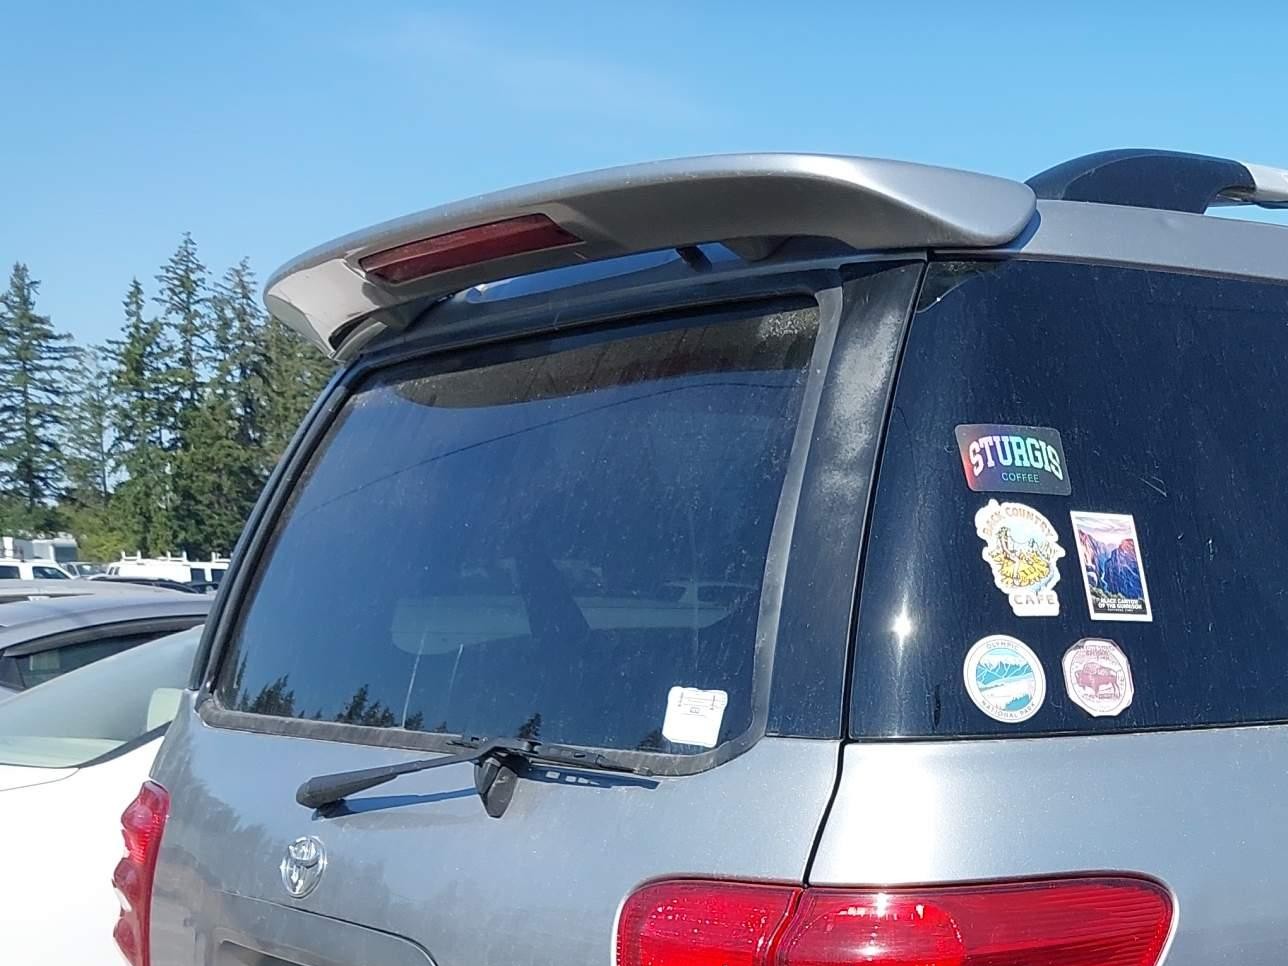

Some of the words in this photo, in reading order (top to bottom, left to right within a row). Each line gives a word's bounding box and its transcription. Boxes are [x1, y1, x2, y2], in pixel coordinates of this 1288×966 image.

[968, 434, 1064, 481] STURGIS
[1001, 472, 1040, 484] COFFEE
[1004, 506, 1054, 537] COUNTRY
[1014, 594, 1055, 605] CAFE
[986, 641, 1020, 650] OLYMPIC
[982, 700, 1018, 718] NATIONAL
[1018, 702, 1035, 716] PARK
